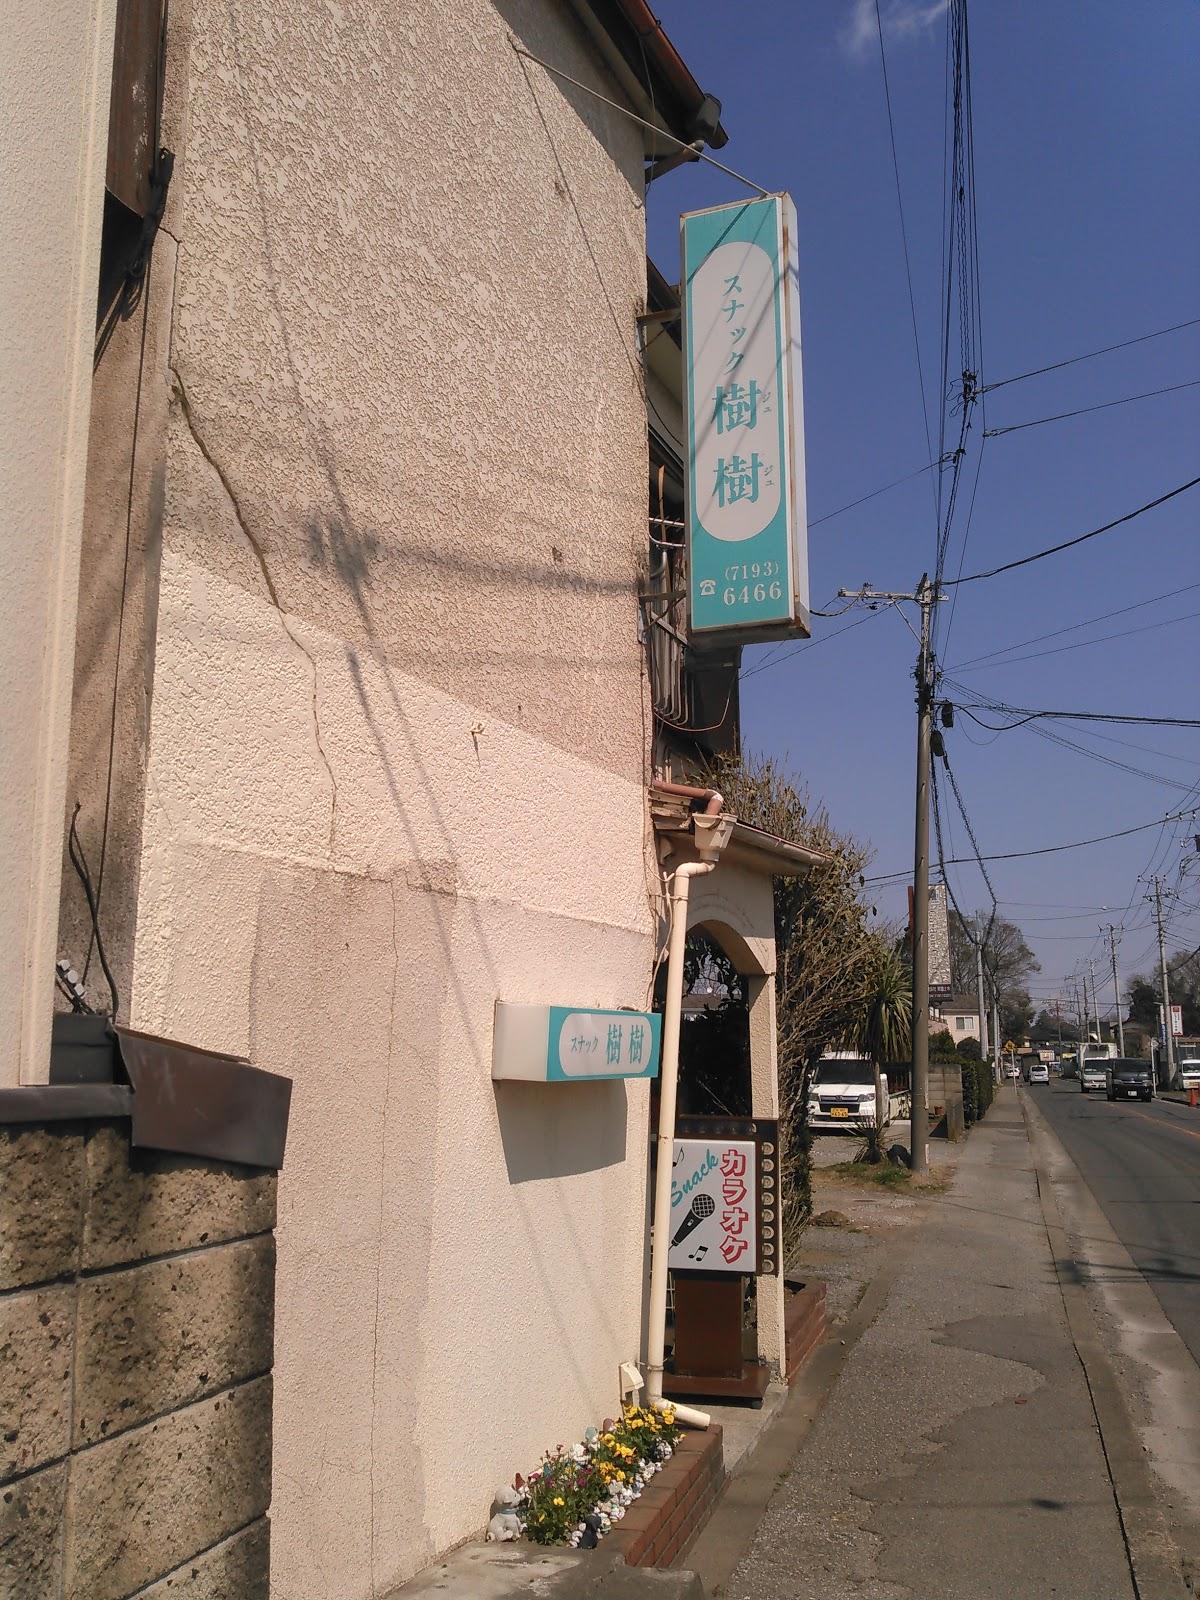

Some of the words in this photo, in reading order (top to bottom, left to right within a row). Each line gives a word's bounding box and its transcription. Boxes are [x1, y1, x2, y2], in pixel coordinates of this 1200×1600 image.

[721, 275, 747, 375] スナック
[725, 561, 780, 581] (7193)
[723, 581, 782, 606] 6466
[570, 1035, 599, 1054] スナック
[671, 1149, 719, 1208] Snack
[719, 1149, 749, 1265] カラオケ
